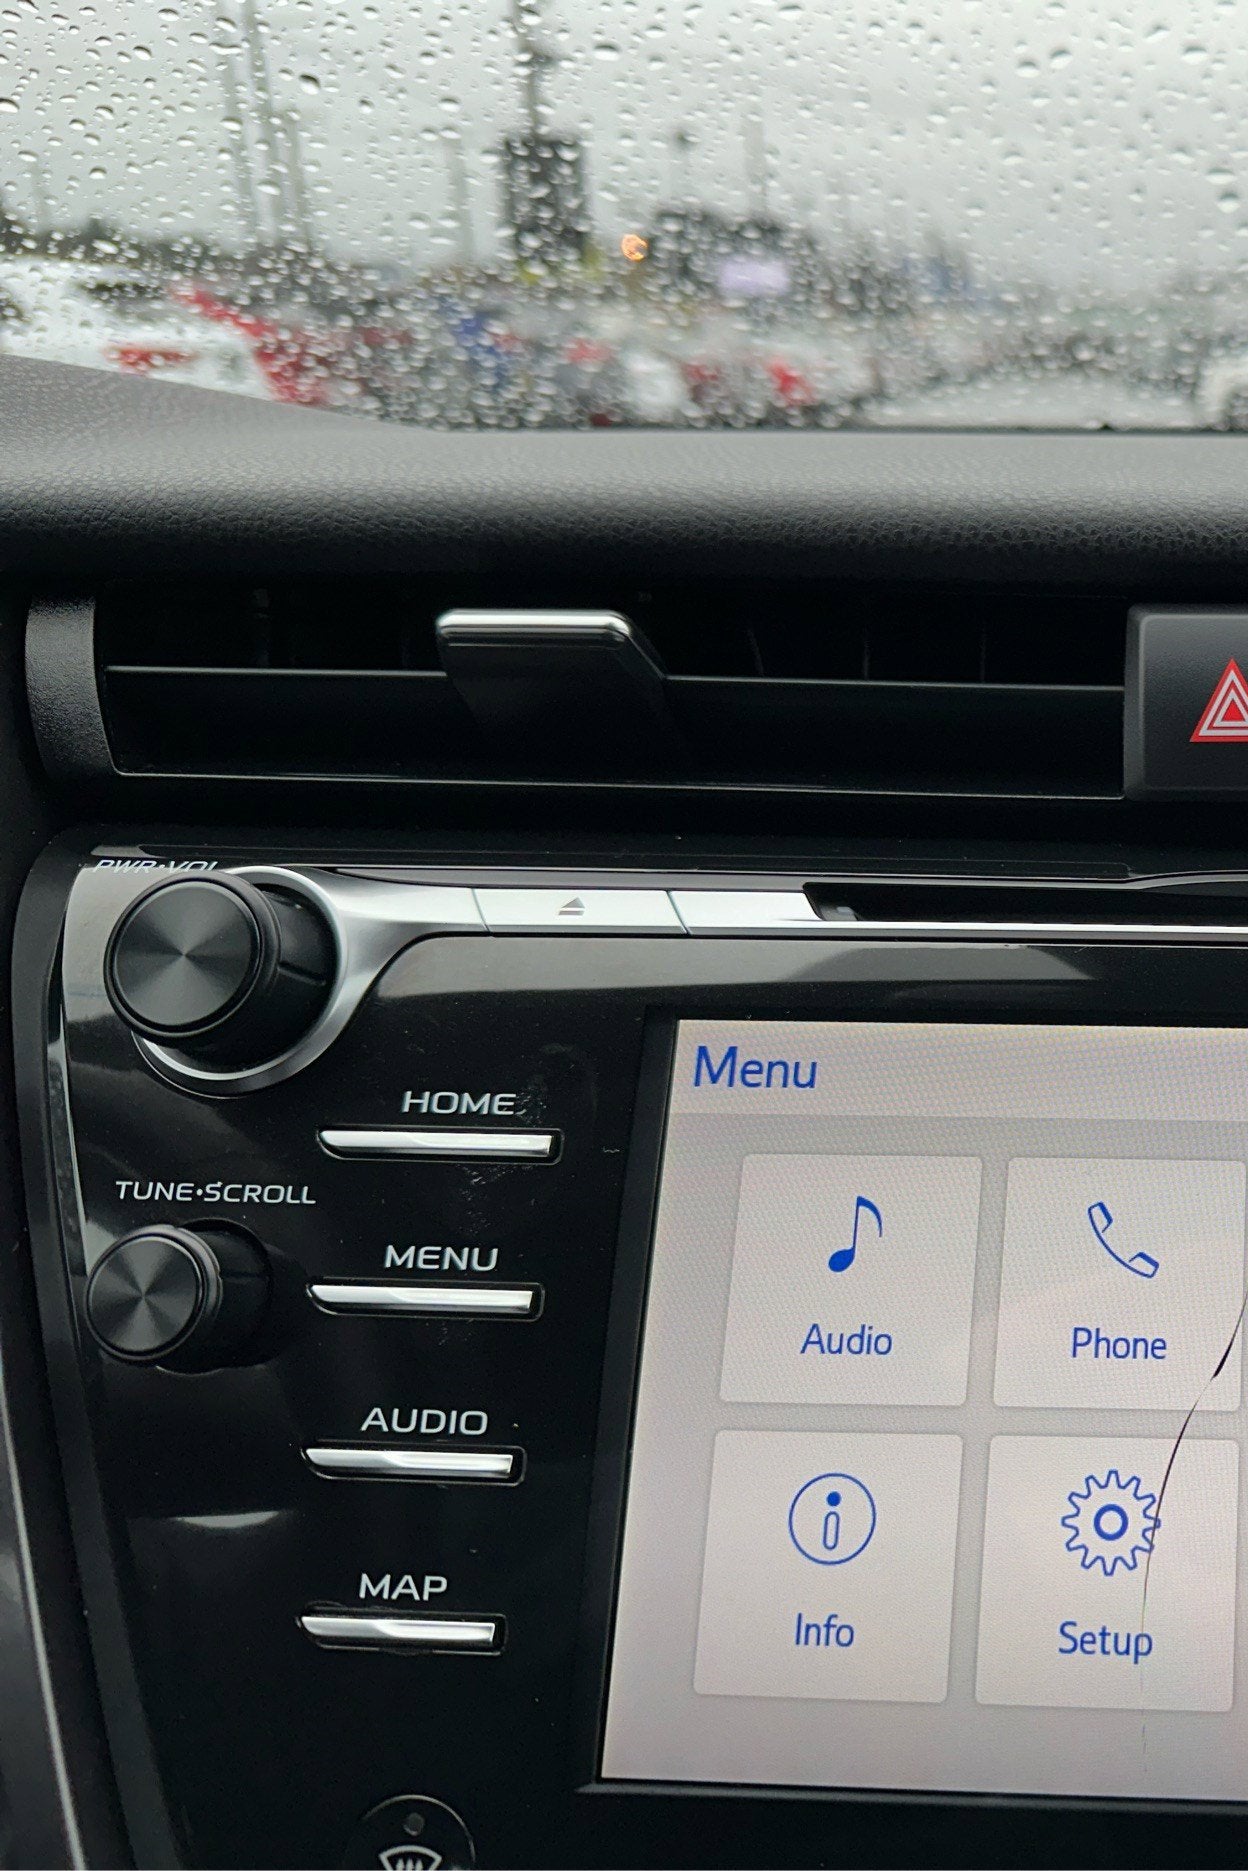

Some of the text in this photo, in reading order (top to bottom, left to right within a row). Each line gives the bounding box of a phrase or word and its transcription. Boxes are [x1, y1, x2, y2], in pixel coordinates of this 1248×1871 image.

[693, 1045, 818, 1089] Menu
[402, 1090, 517, 1116] HOME
[384, 1244, 499, 1272] MENU
[800, 1323, 893, 1356] Audio
[1071, 1326, 1167, 1361] Phone
[360, 1407, 488, 1436] AUDIO
[359, 1573, 448, 1601] MAP
[794, 1612, 855, 1648] Info
[1058, 1619, 1153, 1664] Setup
